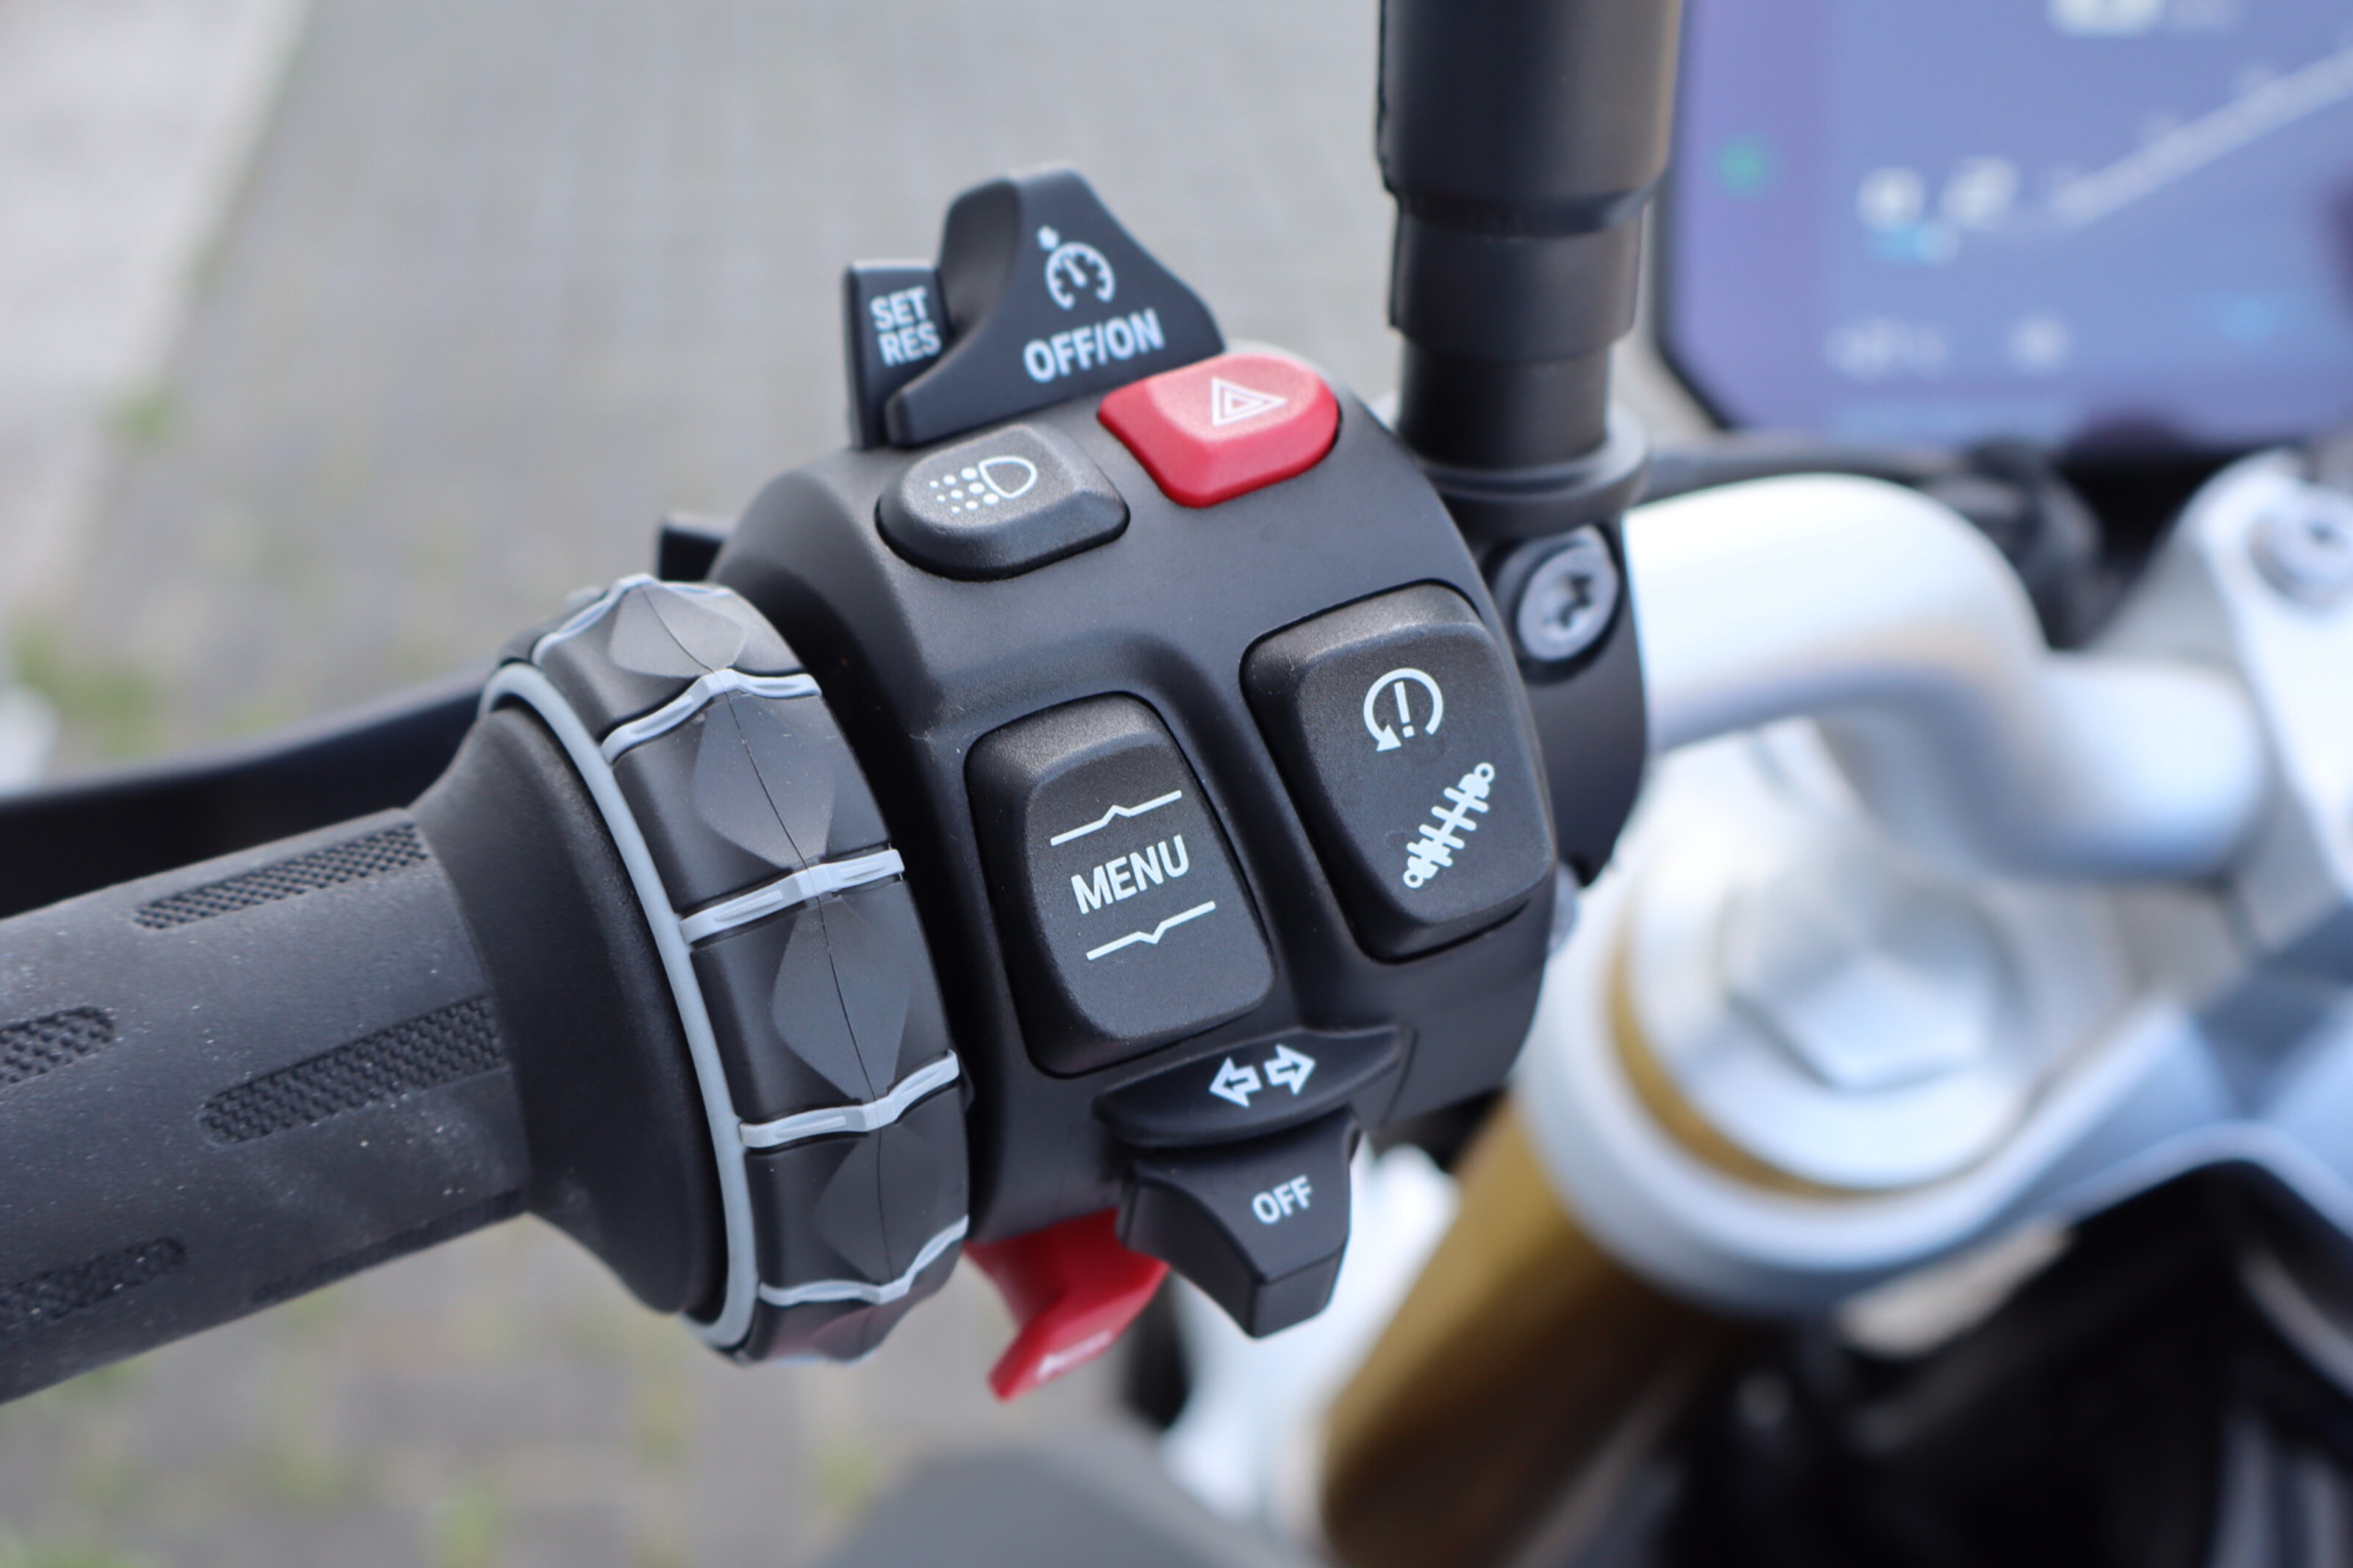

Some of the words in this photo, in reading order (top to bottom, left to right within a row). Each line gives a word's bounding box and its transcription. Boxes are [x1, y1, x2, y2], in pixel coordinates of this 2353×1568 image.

[871, 286, 928, 332] SET
[877, 323, 942, 366] RES
[1024, 307, 1165, 383] OFF/ON
[1071, 834, 1190, 914] MENU
[1252, 1175, 1313, 1225] OFF
